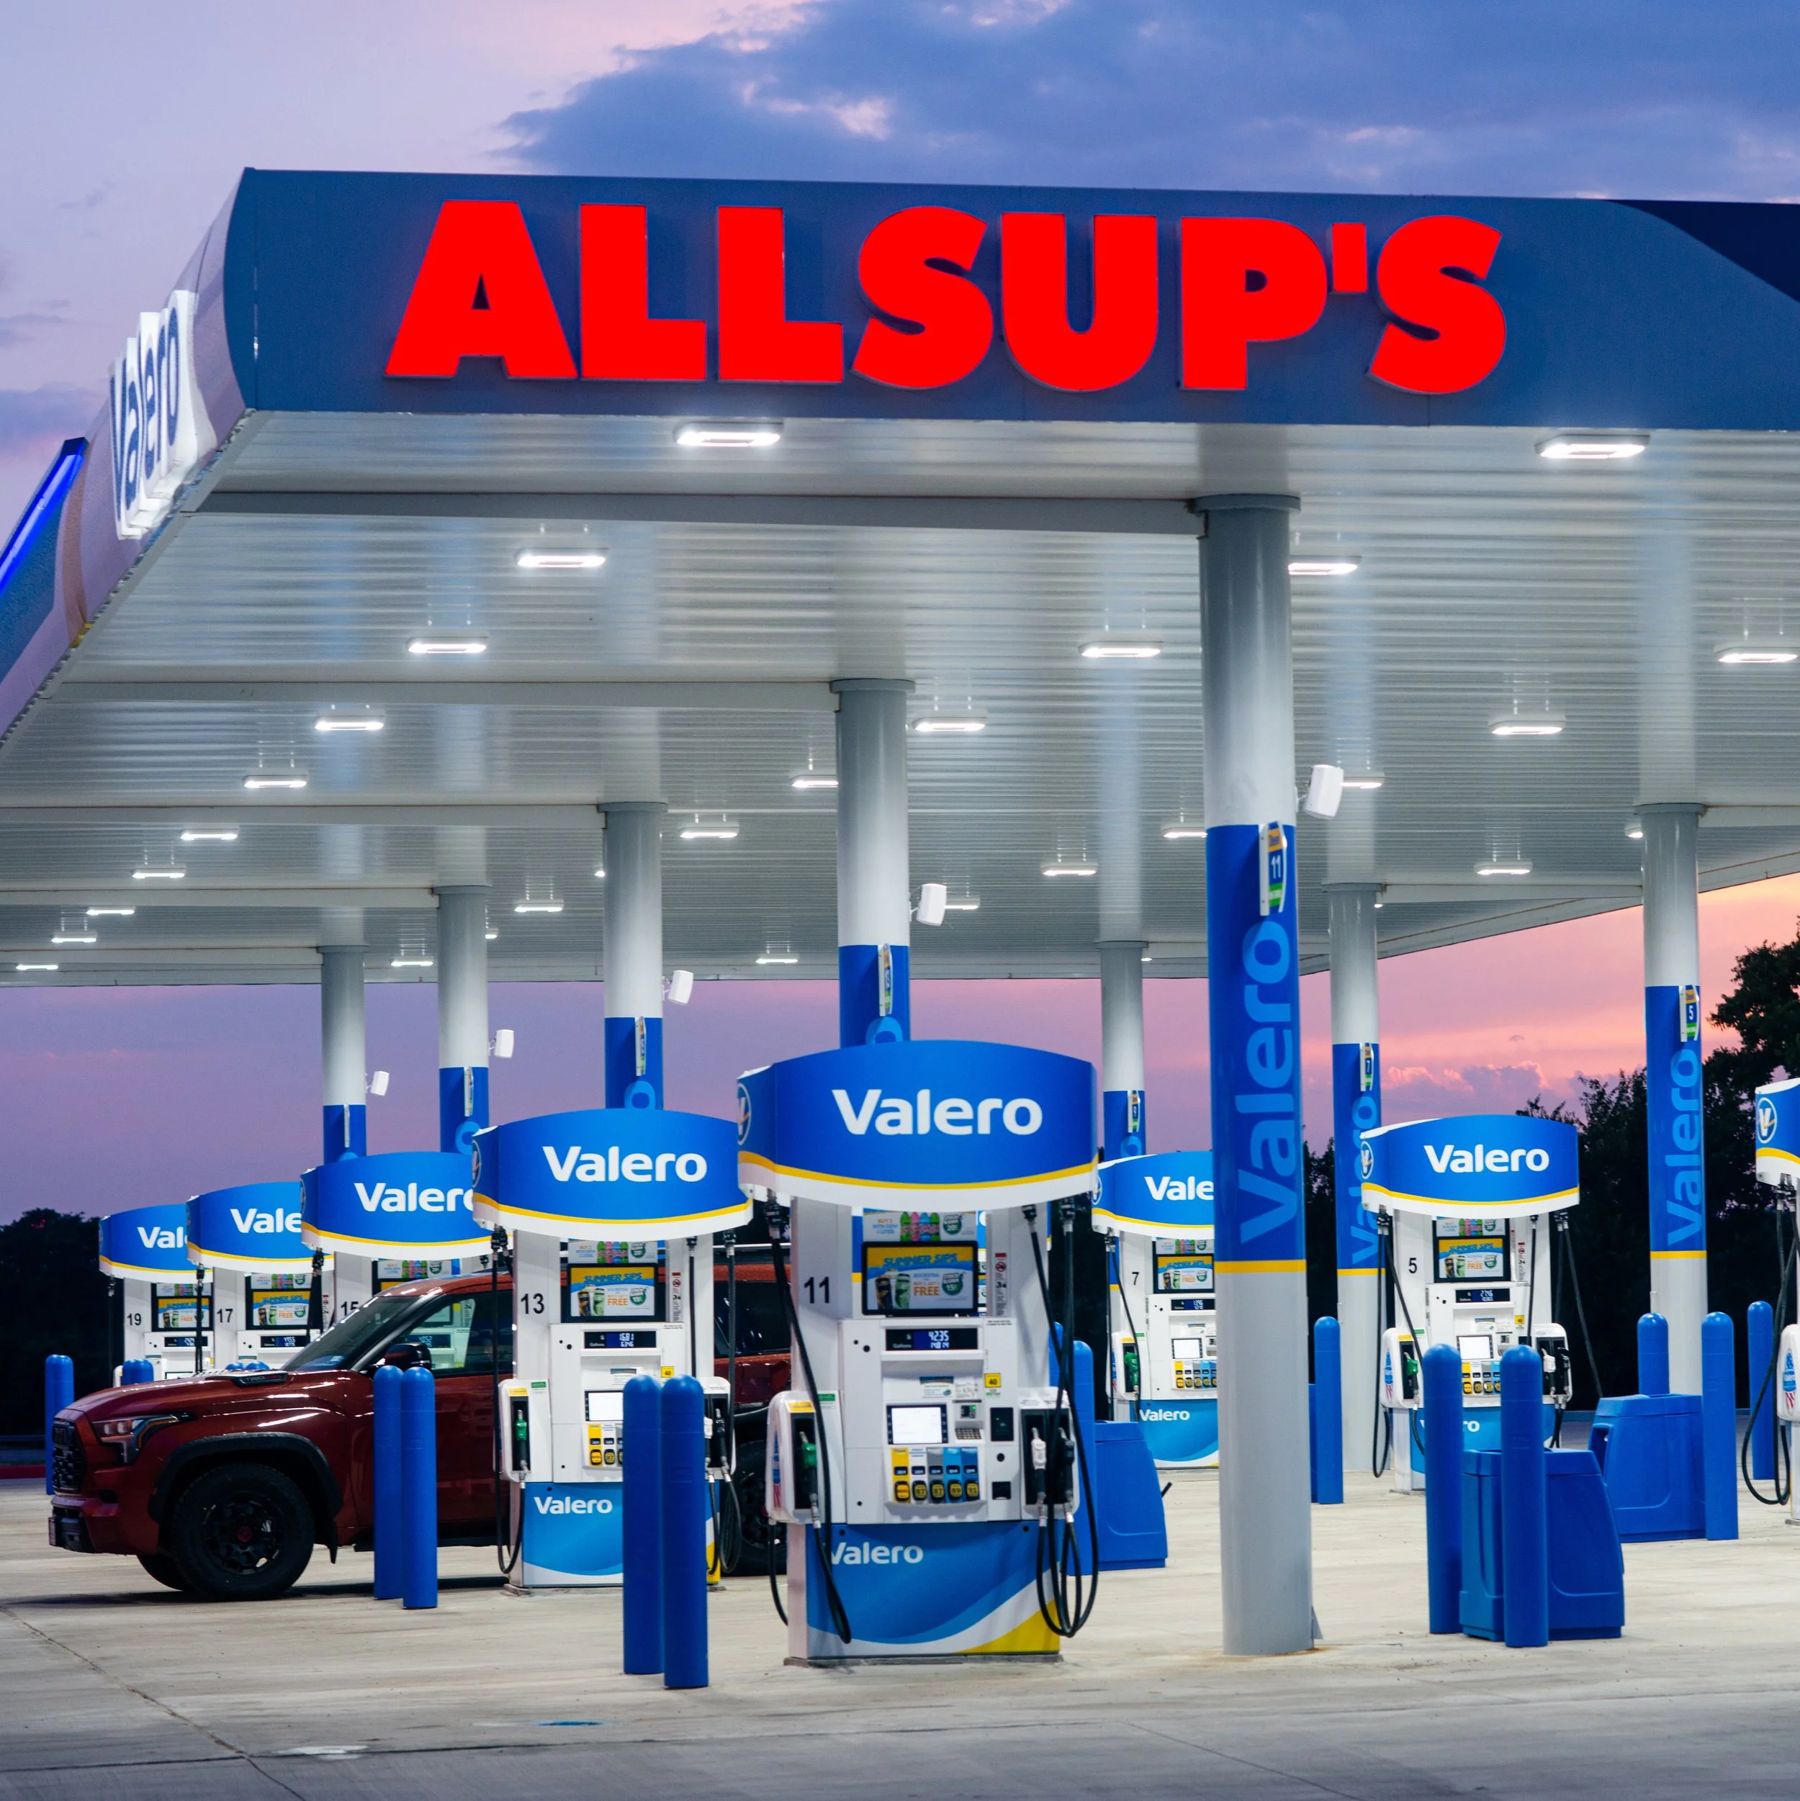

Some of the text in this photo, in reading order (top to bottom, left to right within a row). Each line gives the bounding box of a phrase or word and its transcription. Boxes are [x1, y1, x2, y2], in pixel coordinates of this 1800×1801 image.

[386, 201, 1505, 393] ALLSUP'S
[110, 307, 179, 521] Valero
[1271, 855, 1281, 879] 11
[1688, 1005, 1694, 1020] 5
[1235, 921, 1298, 1244] Valero
[833, 1090, 1043, 1135] Valero
[1664, 1049, 1700, 1246] Valero
[542, 1146, 707, 1182] Valero
[1424, 1145, 1550, 1173] Valero
[137, 1227, 188, 1249] Val
[1408, 1257, 1418, 1274] 5
[1467, 1261, 1482, 1270] FREE
[1132, 1271, 1140, 1285] 7
[804, 1276, 830, 1304] 11
[913, 1286, 939, 1297] FREE
[520, 1292, 545, 1315] 13
[608, 1298, 628, 1306] FREE
[127, 1312, 142, 1327] 19
[217, 1308, 233, 1324] 17
[1139, 1410, 1190, 1422] Valero
[534, 1496, 613, 1515] Valero
